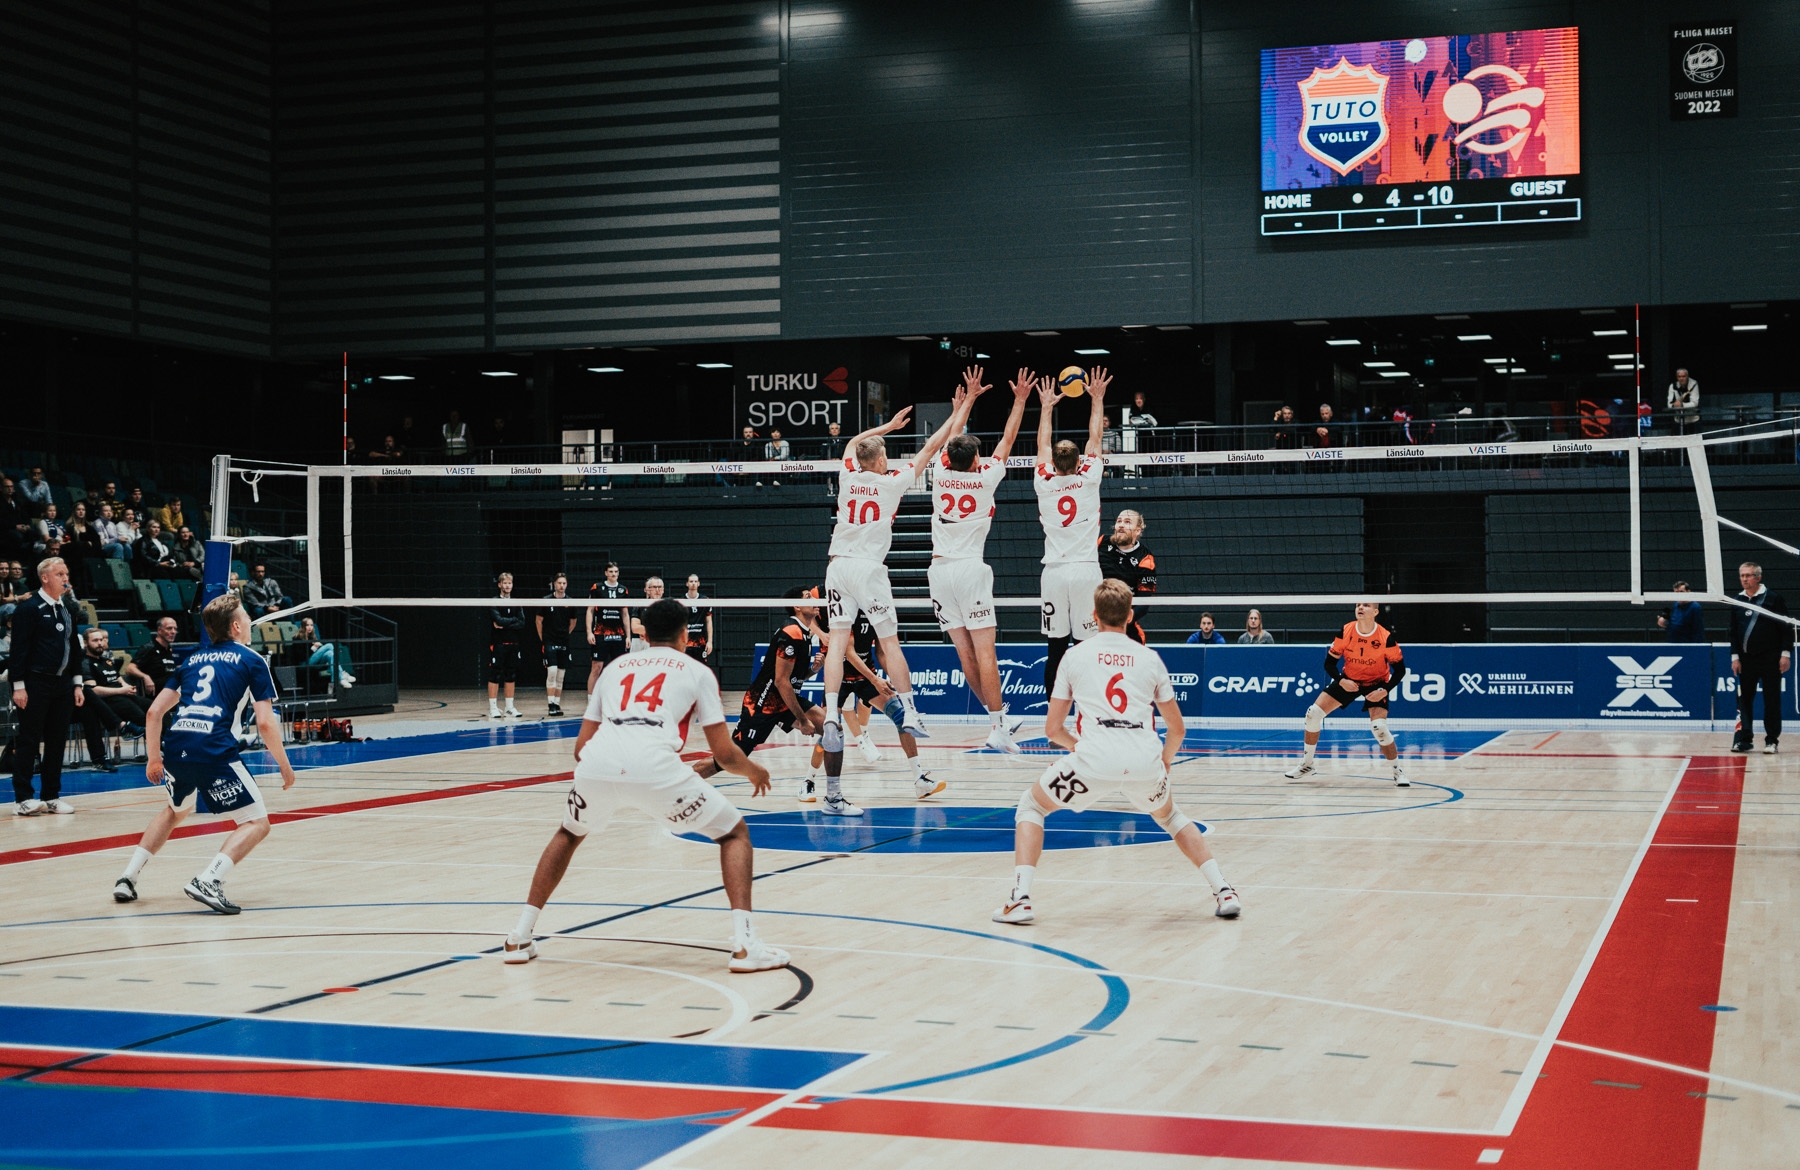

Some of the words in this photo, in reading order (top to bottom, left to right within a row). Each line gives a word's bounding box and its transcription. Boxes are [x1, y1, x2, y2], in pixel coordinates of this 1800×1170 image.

[1674, 28, 1702, 38] F-LIIGA
[1704, 26, 1733, 37] NAISET
[1674, 91, 1703, 100] SUOMEN
[1705, 88, 1734, 98] MESTARI
[1310, 100, 1377, 121] TUTO
[1688, 100, 1721, 114] 2022
[1319, 130, 1369, 144] VOLLEY
[1264, 193, 1312, 209] HOME
[1386, 189, 1400, 207] 4
[1510, 180, 1566, 197] GUEST
[747, 372, 817, 392] TURKU
[748, 399, 848, 428] SPORT
[381, 467, 412, 476] LänsiAuto
[445, 467, 476, 475] VAISTE
[510, 466, 542, 475] LänsiAuto
[576, 465, 608, 474] VAISTE
[643, 465, 675, 474] LänsiAuto
[711, 464, 744, 473] VAISTE
[780, 463, 814, 472] LänsiAuto
[1005, 458, 1034, 467] AISTE
[1149, 454, 1186, 463] VAISTE
[1227, 452, 1265, 462] LänsiAuto
[1305, 450, 1343, 460] VAISTE
[1386, 448, 1424, 458] LänsiAuto
[1468, 445, 1507, 455] VAISTE
[1552, 442, 1593, 453] LänsiAuto
[850, 484, 879, 496] SIIRILÄ
[847, 499, 880, 525] 10
[940, 492, 977, 519] 29
[1057, 495, 1077, 528] 9
[860, 622, 869, 634] 17
[188, 650, 242, 666] SIHVONEN
[618, 657, 686, 671] GROFFIER
[1097, 650, 1135, 667] FÖRSTI
[192, 664, 215, 702] 3
[951, 669, 965, 688] Oy
[1181, 675, 1195, 683] OY
[1208, 675, 1296, 694] CRAFT
[1615, 675, 1673, 689] SEC
[619, 672, 667, 713] 14
[1105, 671, 1128, 715] 6
[1487, 683, 1574, 695] MEHILÄINEN
[210, 783, 244, 802] VICHY
[667, 791, 707, 823] VICHY
